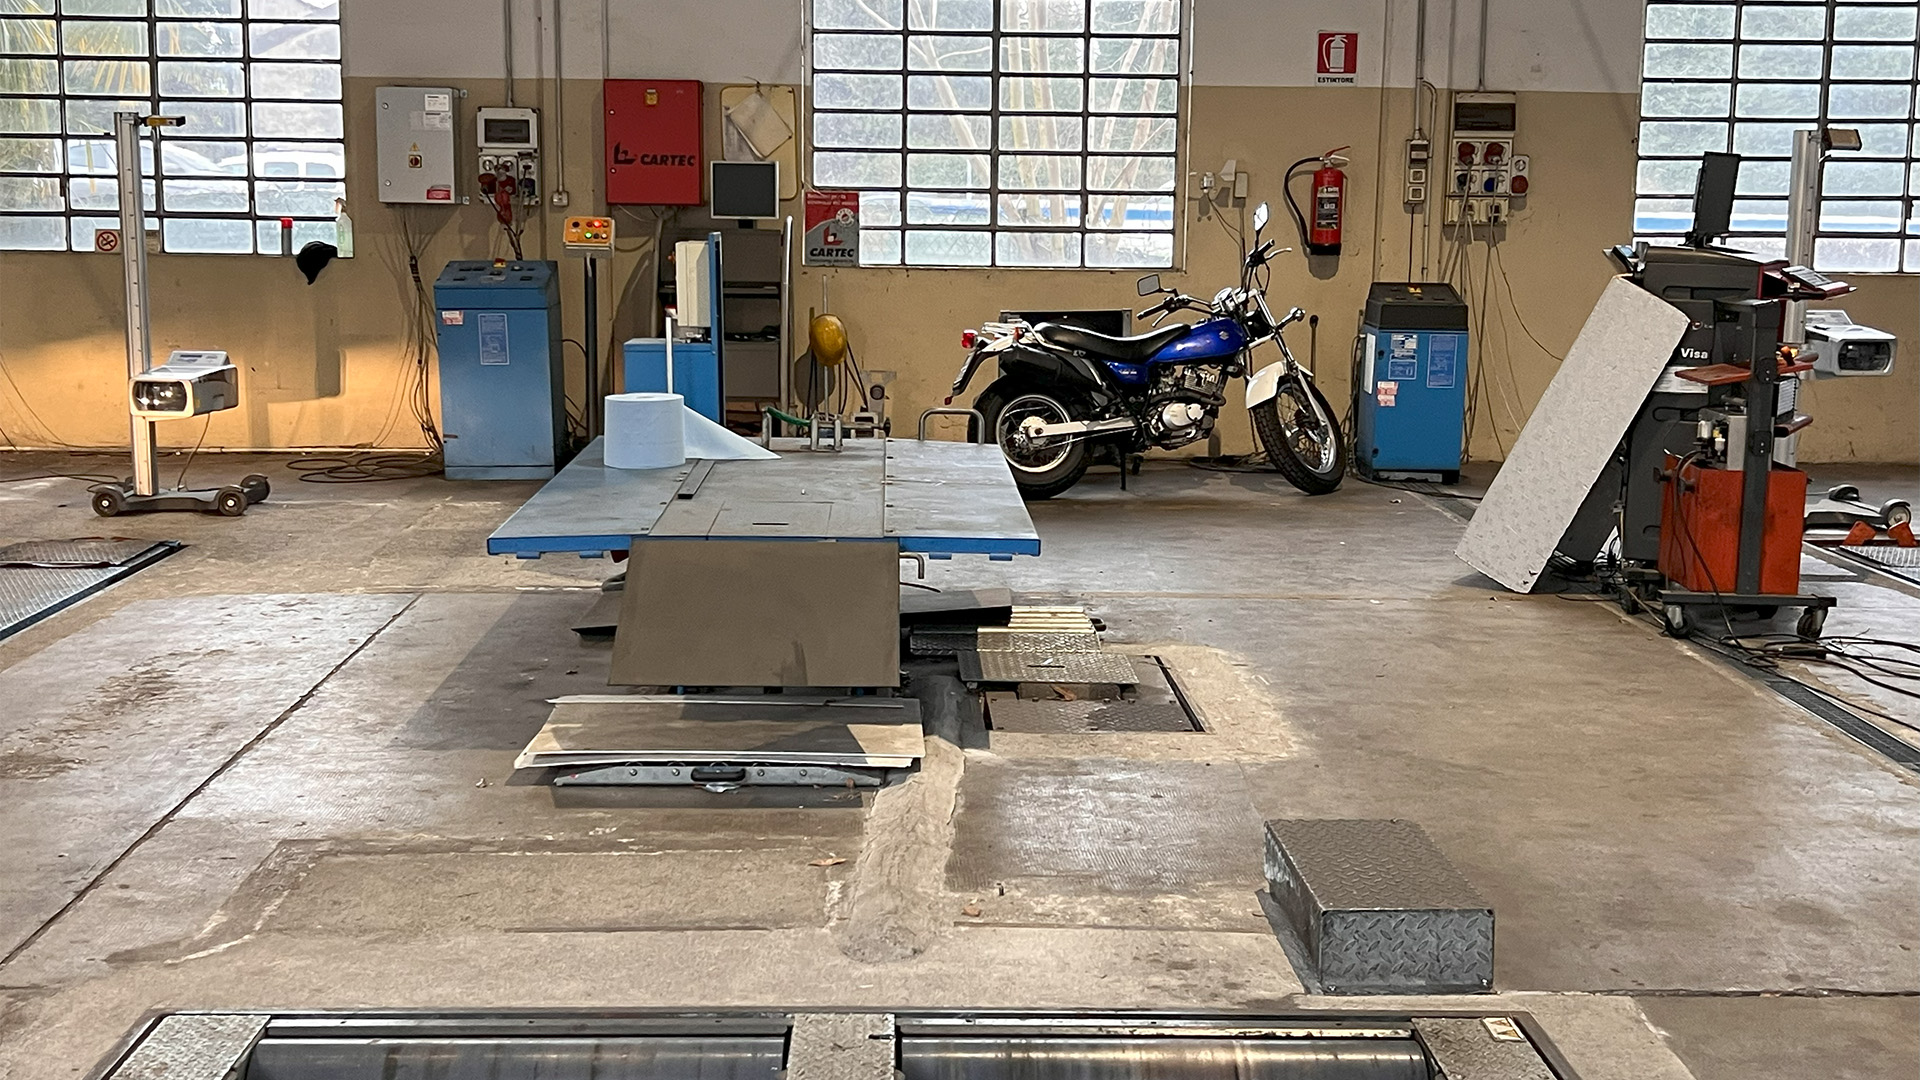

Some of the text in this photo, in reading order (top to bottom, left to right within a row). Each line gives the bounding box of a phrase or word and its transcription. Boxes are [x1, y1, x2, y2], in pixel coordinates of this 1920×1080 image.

[640, 153, 696, 167] CARTEC
[809, 247, 855, 258] CARTEC
[1680, 347, 1709, 359] Visa
